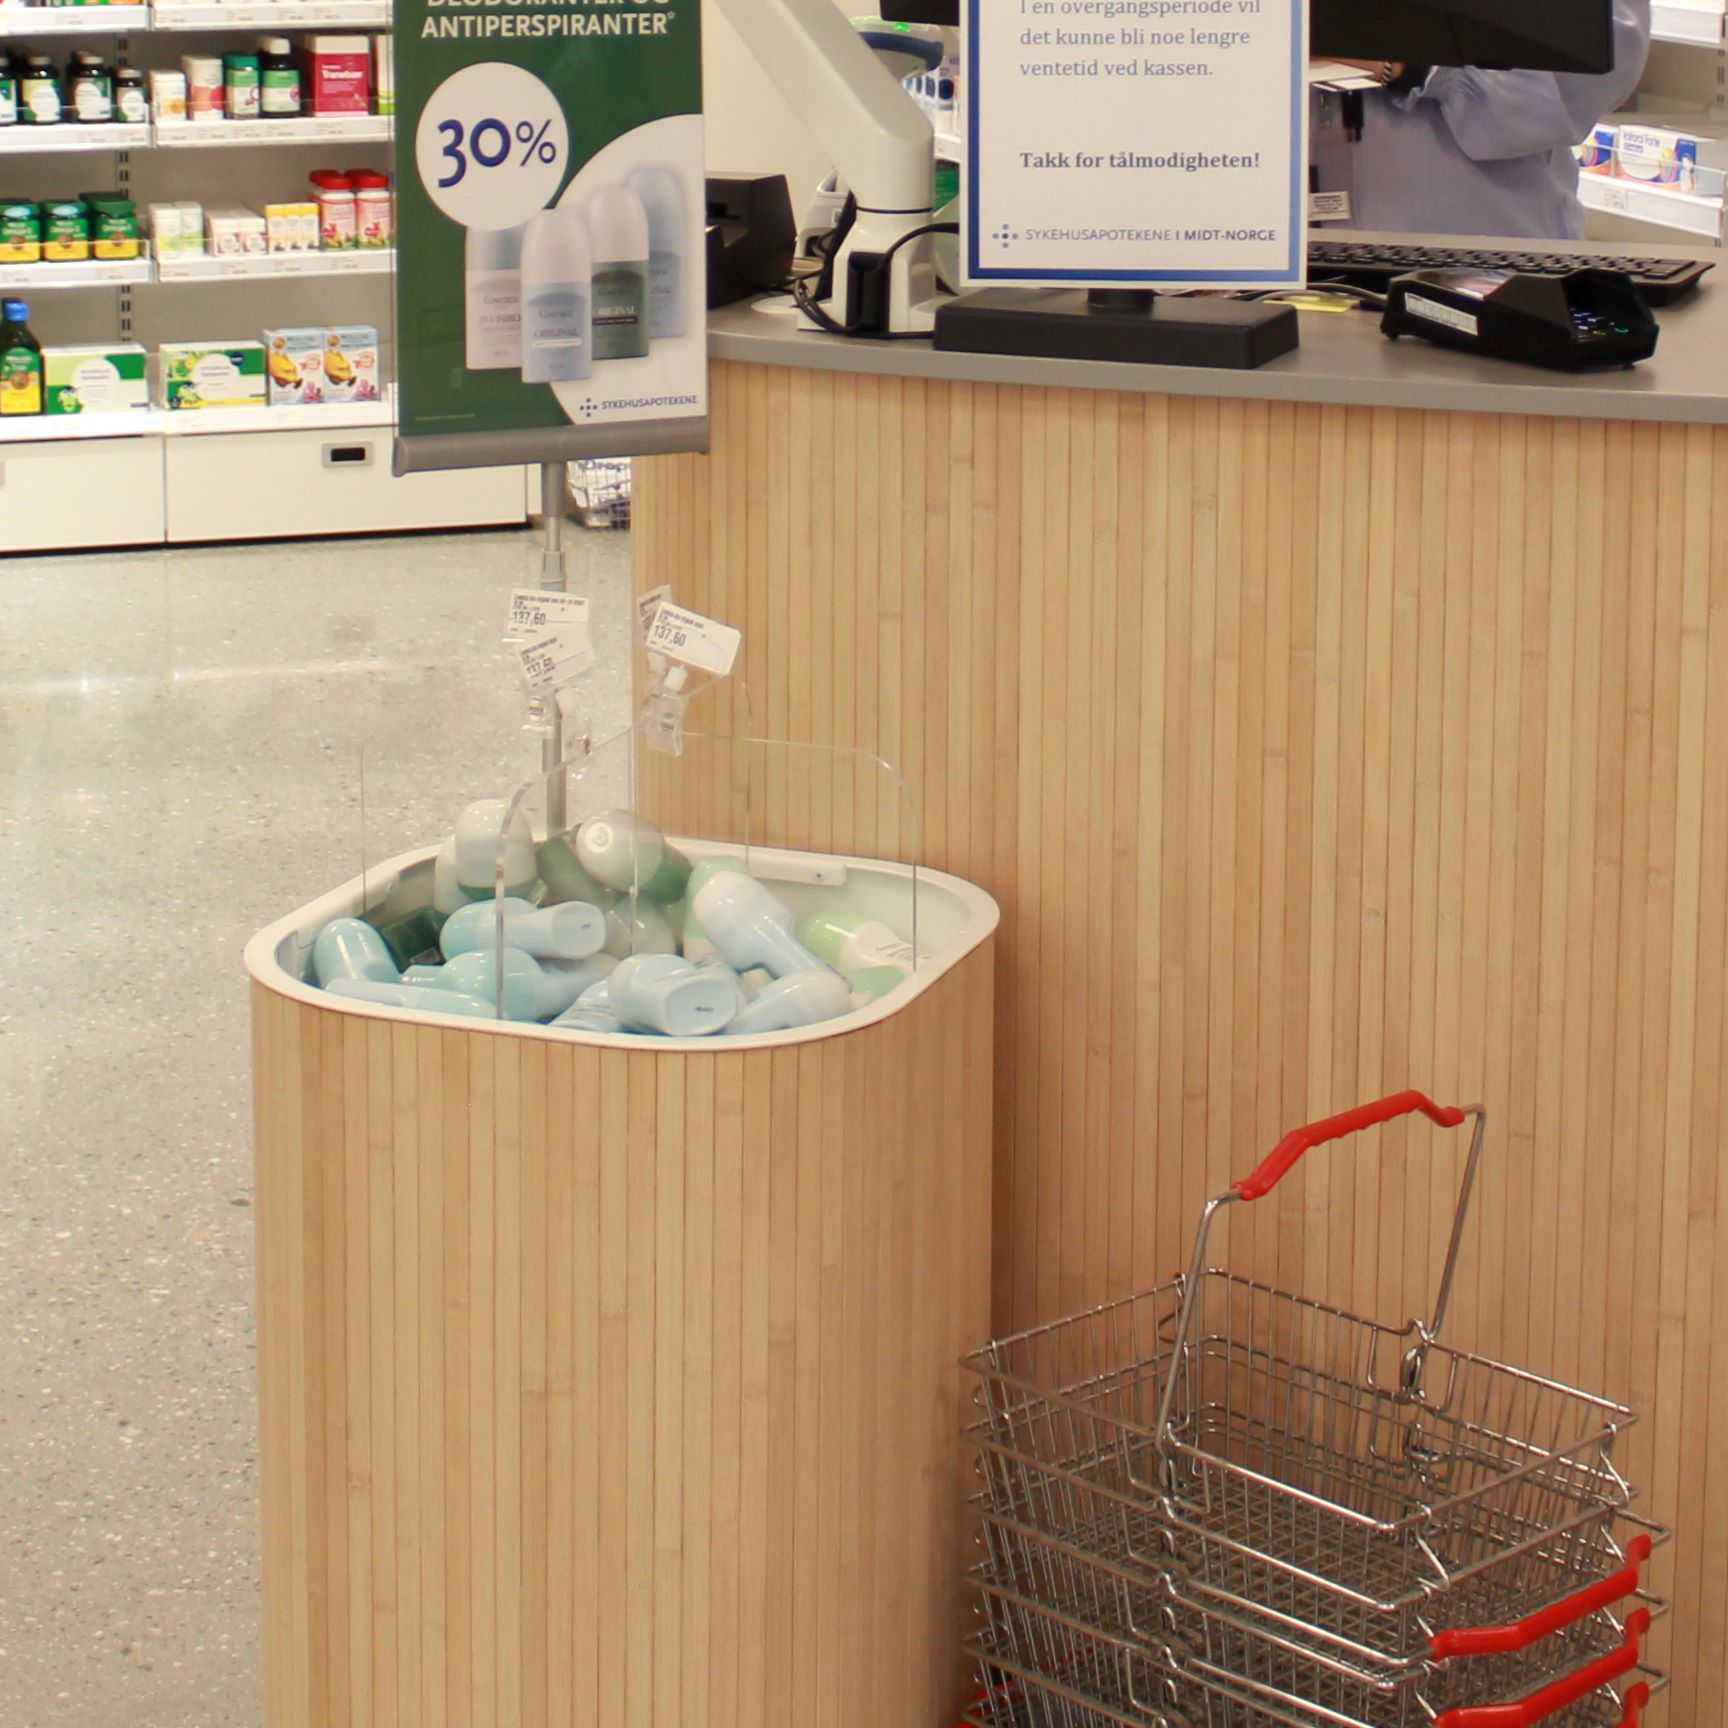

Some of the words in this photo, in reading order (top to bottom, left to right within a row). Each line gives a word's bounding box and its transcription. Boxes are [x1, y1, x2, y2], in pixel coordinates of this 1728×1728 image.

[1032, 1, 1055, 14] en
[1020, 28, 1051, 45] det
[1056, 28, 1116, 45] kunne
[1121, 28, 1145, 45] bli
[1150, 31, 1186, 45] noe
[1190, 28, 1251, 50] lengre
[1019, 59, 1099, 76] ventetid
[1104, 59, 1139, 76] ved
[1143, 59, 1214, 76] kassen.
[437, 118, 557, 189] 30%
[1019, 152, 1071, 169] Takk
[1075, 152, 1104, 169] for
[1109, 152, 1261, 172] tålmodigheten!
[1025, 229, 1171, 242] SYKEHUSAPOTEKENE
[1175, 229, 1181, 241] I
[1184, 229, 1277, 242] MIDT-NORGE
[534, 328, 578, 338] ORIGINAL
[601, 394, 698, 411] SYKEHUSAPOTEKENE
[653, 623, 687, 647] 137,60
